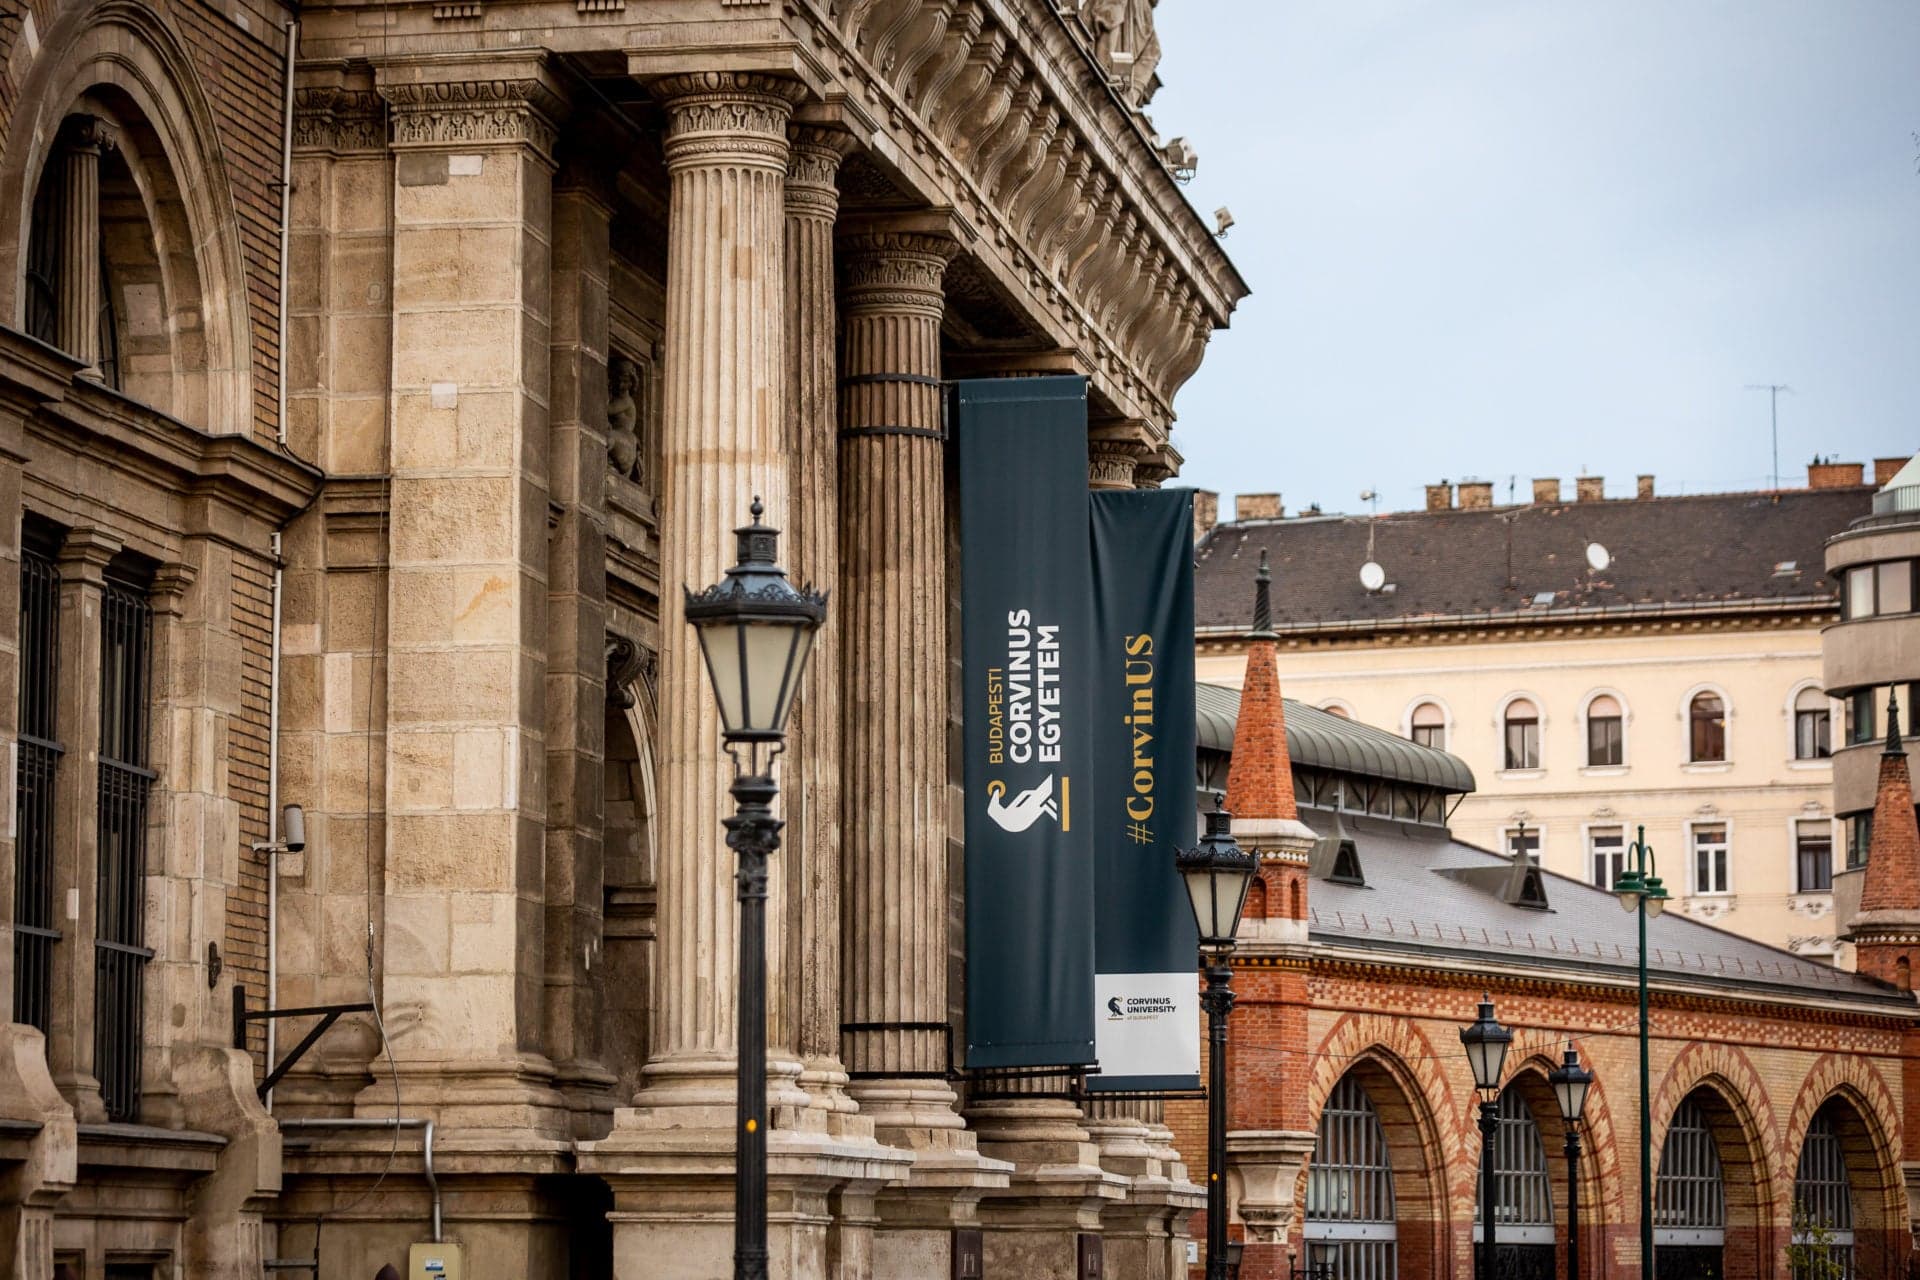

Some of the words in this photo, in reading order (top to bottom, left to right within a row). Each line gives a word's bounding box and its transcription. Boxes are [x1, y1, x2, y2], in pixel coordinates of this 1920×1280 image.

[988, 668, 1004, 764] BUDAPESTI
[1008, 608, 1032, 763] CORVINUS
[1037, 625, 1061, 762] EGYETEM
[1124, 633, 1154, 845] #CorvinUS
[1127, 997, 1170, 1005] CORVINUS
[1127, 1005, 1176, 1013] UNIVERSITY
